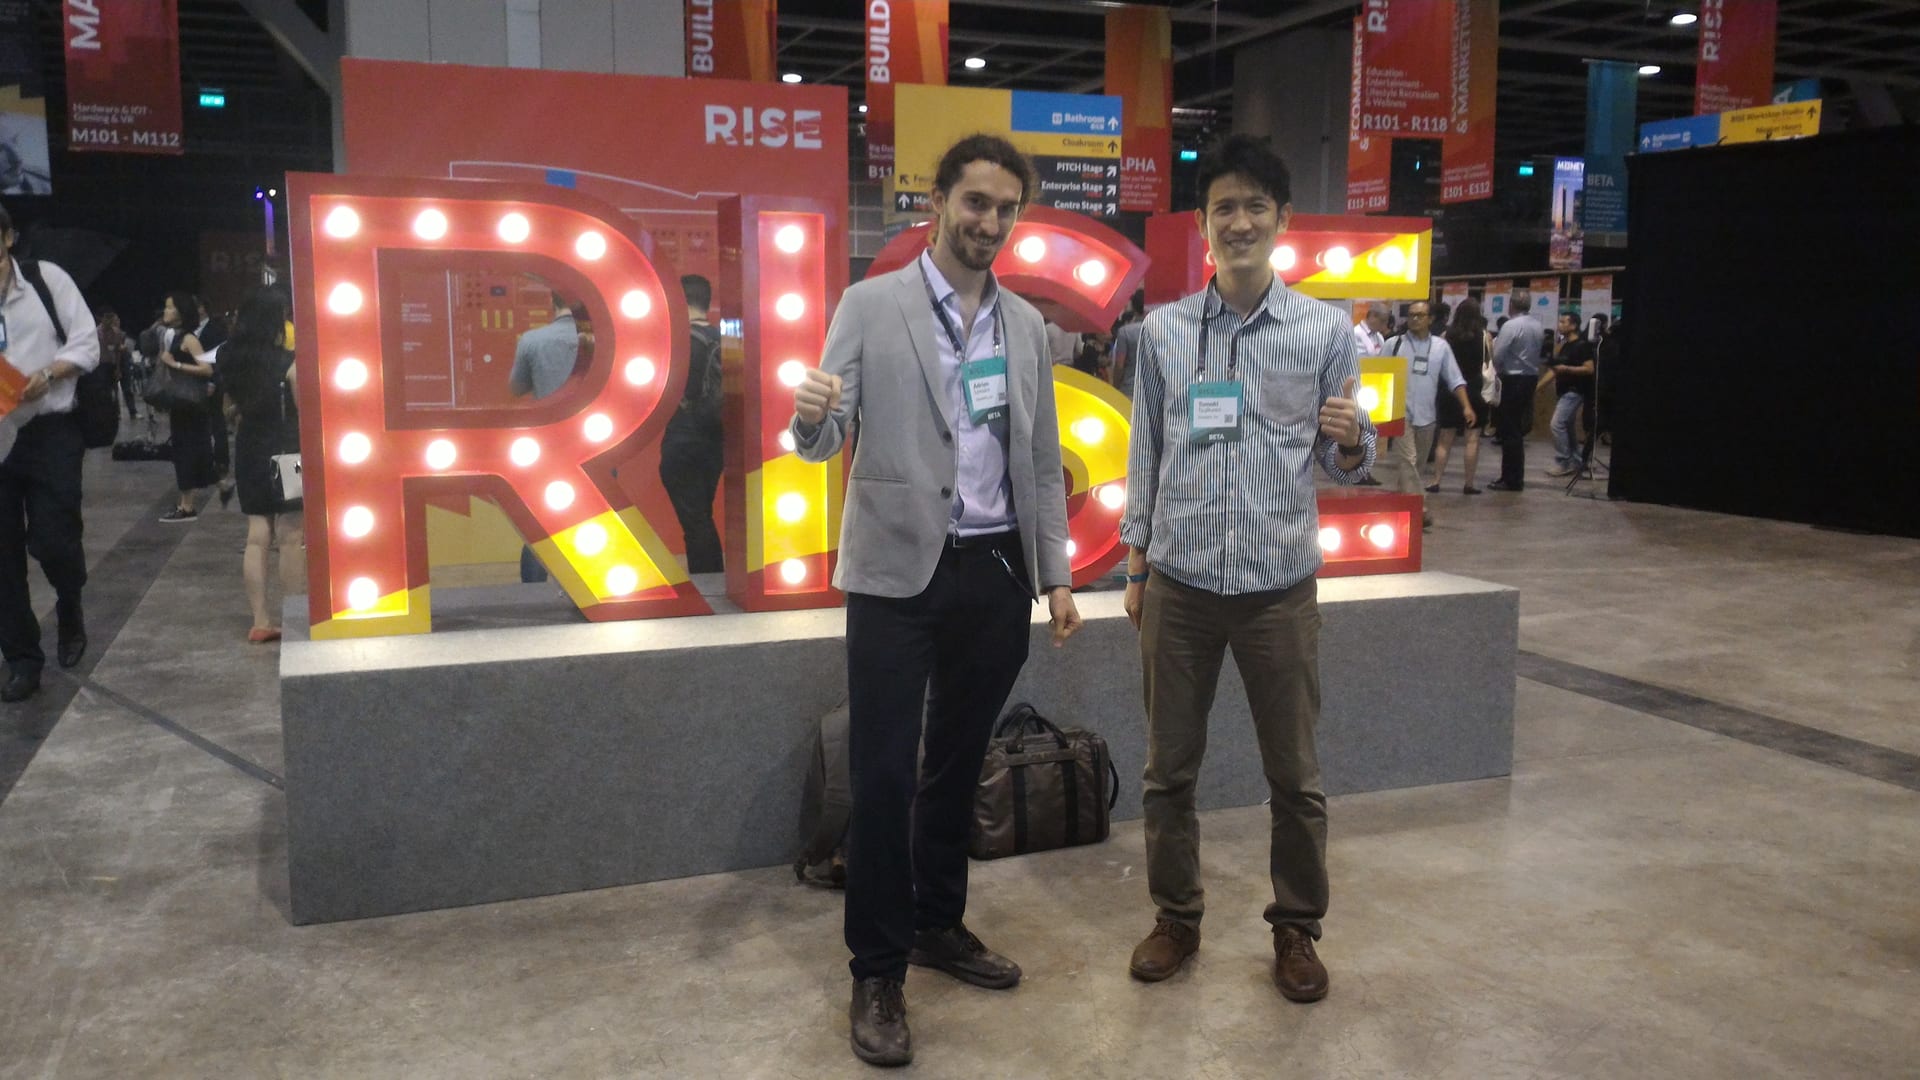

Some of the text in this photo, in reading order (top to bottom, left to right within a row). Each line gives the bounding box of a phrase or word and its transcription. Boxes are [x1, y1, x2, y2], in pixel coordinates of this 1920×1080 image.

[869, 0, 891, 84] BUILD
[1366, 67, 1404, 78] Education
[72, 103, 119, 114] Hardware
[73, 112, 110, 124] Gaming
[1064, 112, 1105, 123] Bathroom
[1363, 114, 1400, 130] R101
[1411, 116, 1448, 132] R118
[704, 104, 822, 149] RISE
[72, 128, 119, 144] M101
[133, 130, 180, 147] M112
[1062, 138, 1104, 148] Cloakroom
[1056, 161, 1104, 174] PITCH Stage
[1587, 174, 1615, 187] BETA
[1041, 181, 1103, 194] Enterprise Stage
[1054, 200, 1103, 212] Centre Stage
[987, 411, 1001, 420] BETA
